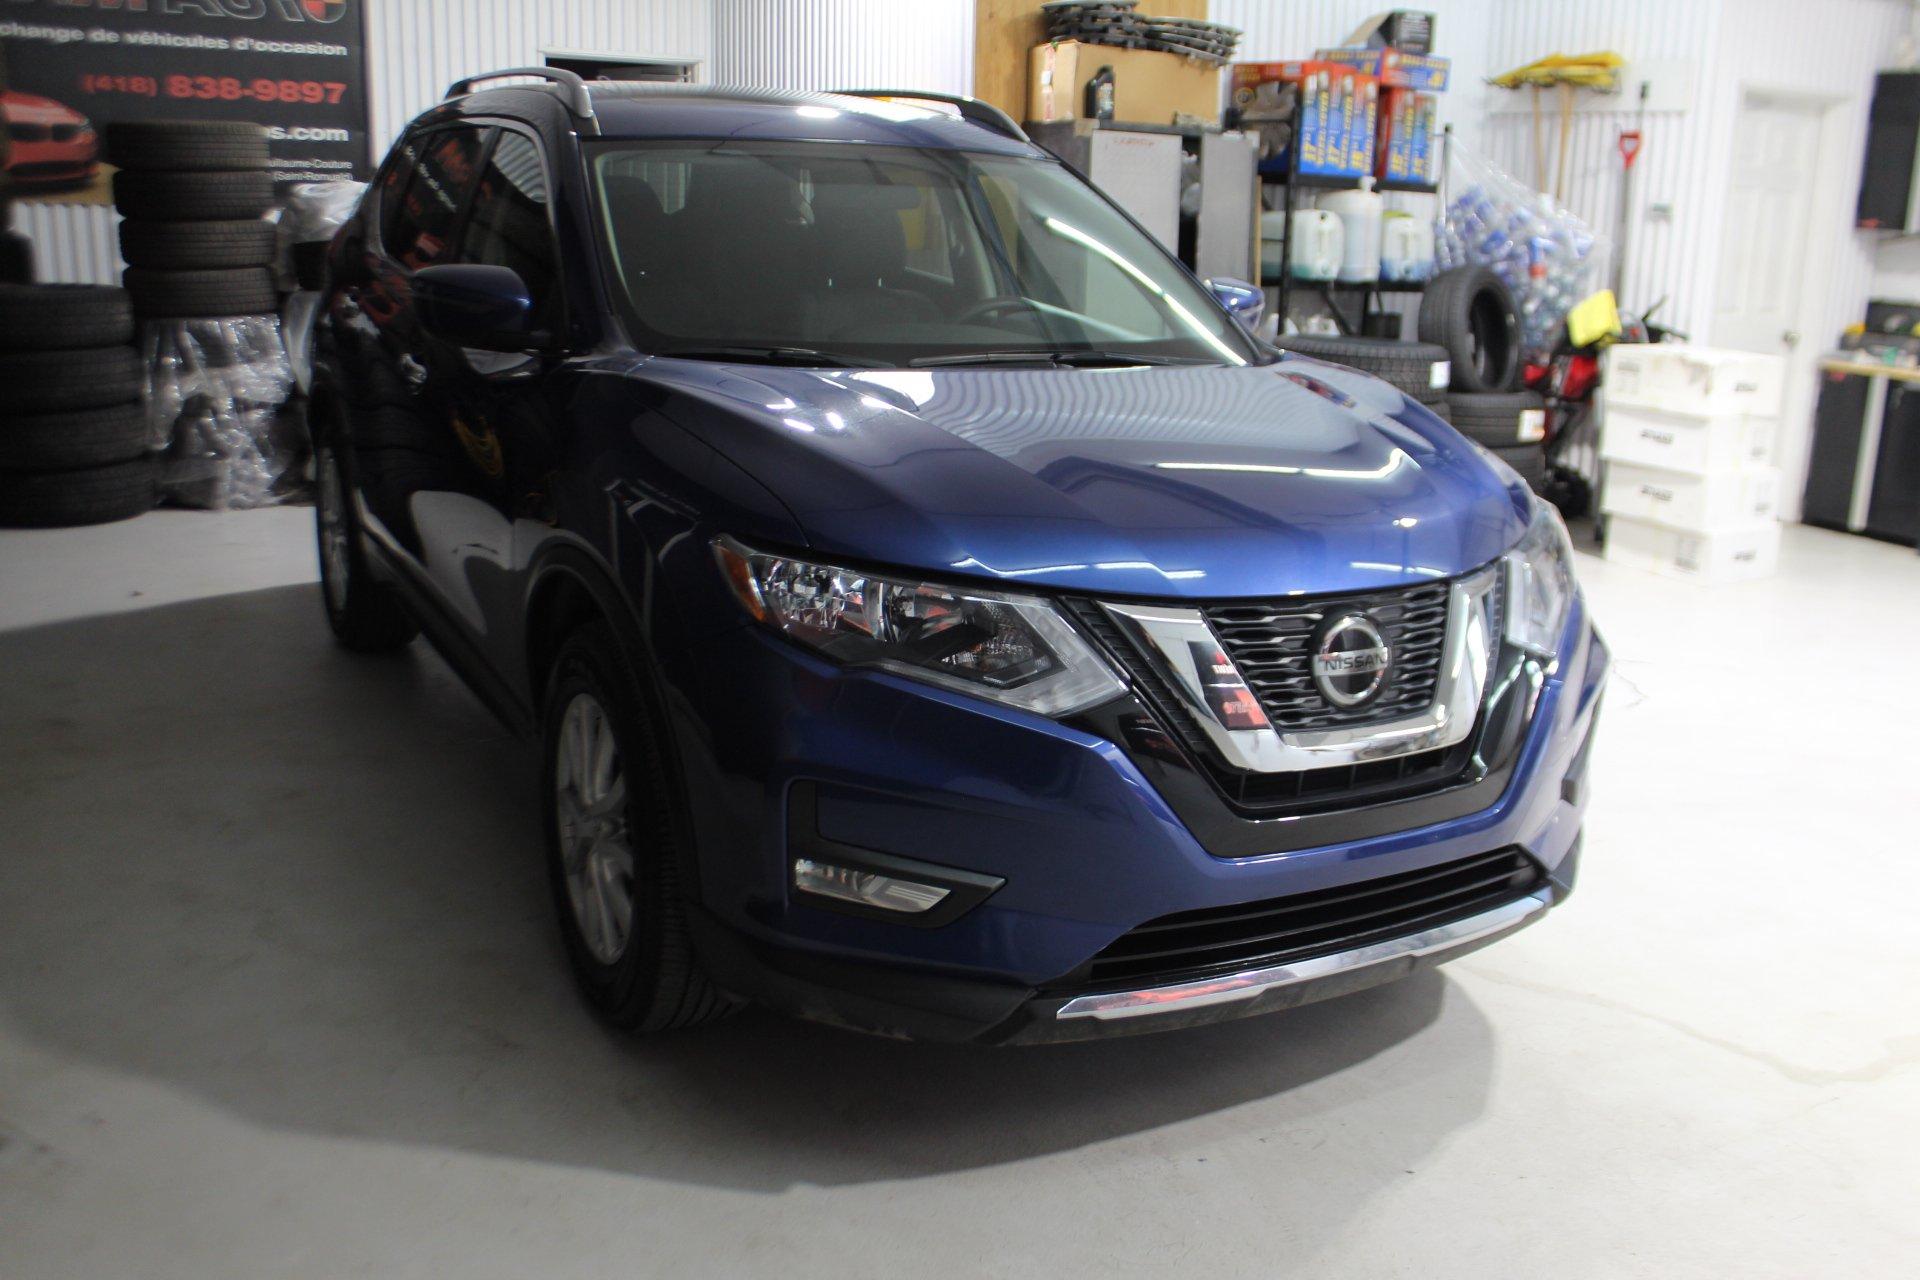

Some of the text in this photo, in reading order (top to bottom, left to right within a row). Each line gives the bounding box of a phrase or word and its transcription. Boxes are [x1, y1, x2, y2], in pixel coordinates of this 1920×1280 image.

[89, 28, 120, 43] de
[123, 31, 230, 50] véhicules
[234, 37, 348, 56] d'occasion
[83, 75, 347, 104] (418) 838-9897
[1325, 654, 1388, 671] NISSAN
